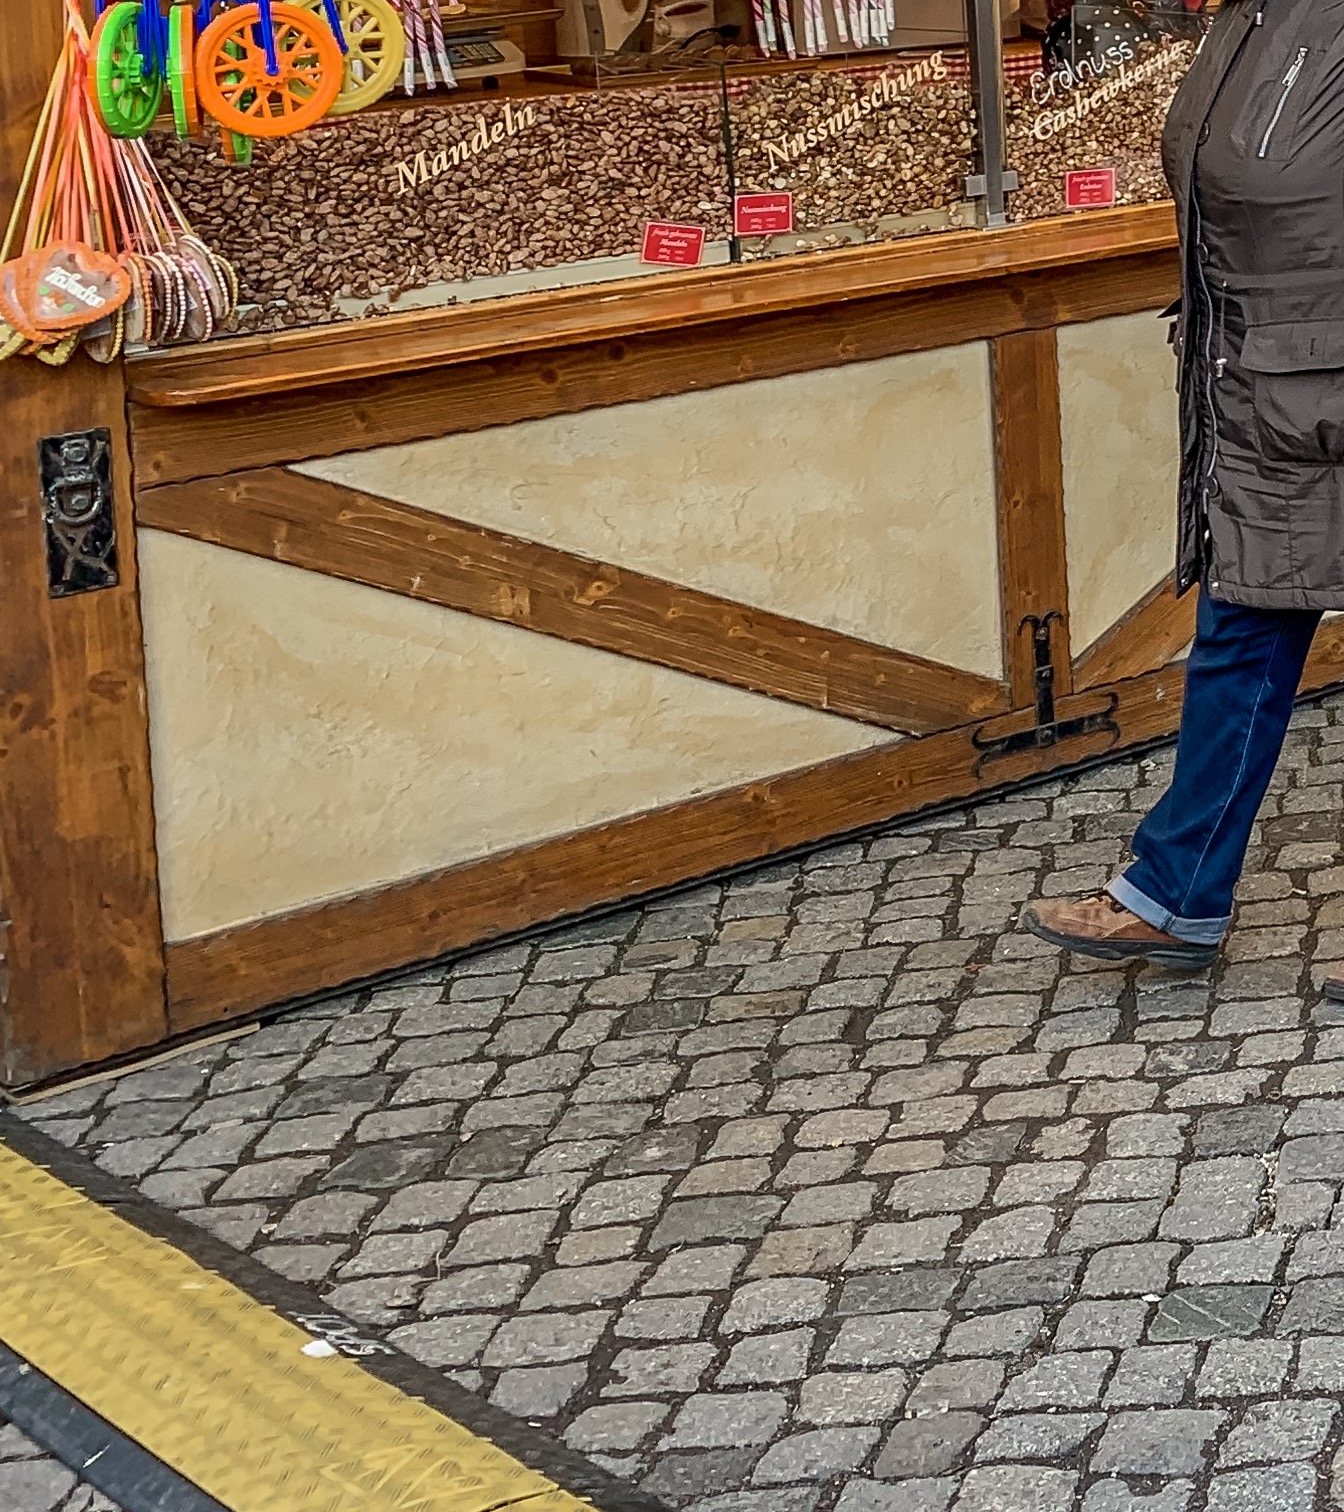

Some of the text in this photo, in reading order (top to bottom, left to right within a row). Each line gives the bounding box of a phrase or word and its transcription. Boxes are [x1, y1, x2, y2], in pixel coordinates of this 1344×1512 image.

[765, 50, 948, 173] Nussmischung
[1030, 41, 1135, 105] Erdnuss
[394, 102, 538, 196] Mandeln
